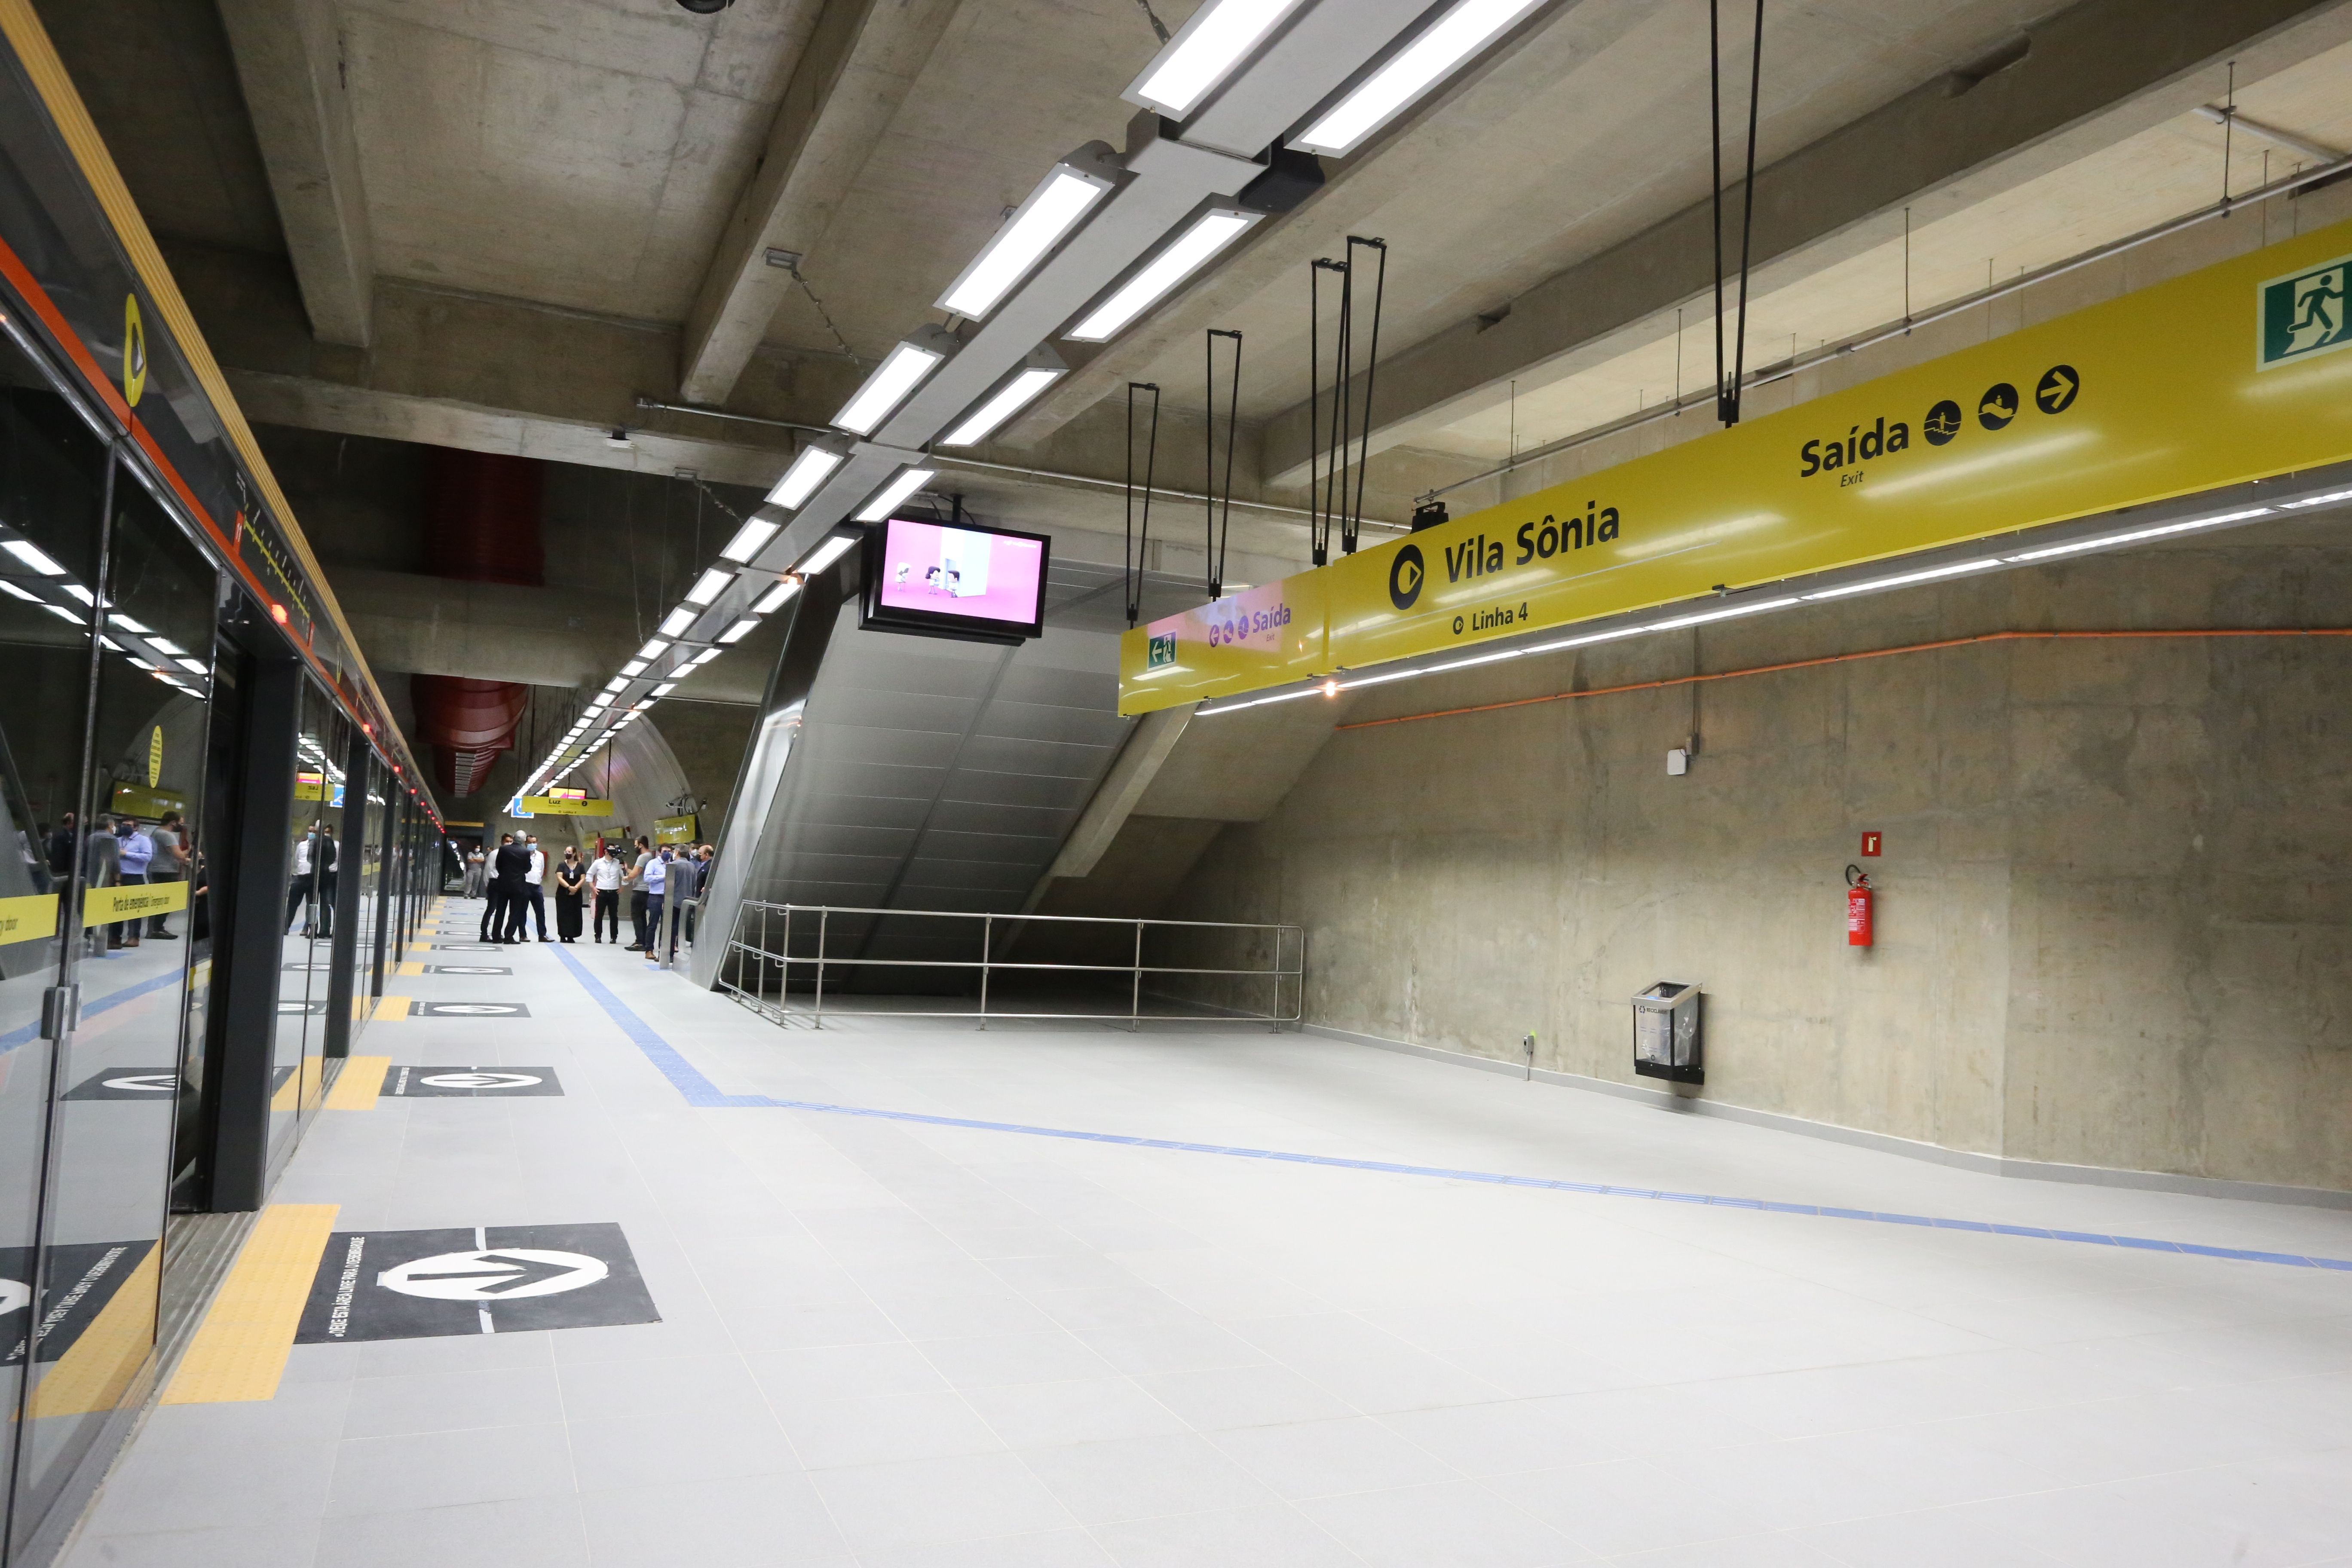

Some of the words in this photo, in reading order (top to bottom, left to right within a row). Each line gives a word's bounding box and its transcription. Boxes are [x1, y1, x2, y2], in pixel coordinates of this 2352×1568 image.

[1801, 416, 1909, 478] Saída
[1840, 471, 1864, 488] Exit
[1445, 534, 1504, 583] Vila
[1516, 500, 1620, 566] Sônia
[1253, 603, 1291, 633] Saída
[1472, 606, 1513, 631] Linha
[1518, 602, 1528, 621] 4
[1266, 634, 1275, 642] Exit
[346, 1237, 365, 1264] DESEMBARQUE
[341, 1267, 359, 1280] PARA
[338, 1280, 356, 1293] LIVRE
[331, 1292, 353, 1305] ÁREA
[332, 1305, 350, 1318] ESTA
[328, 1319, 348, 1334] DEIXE
